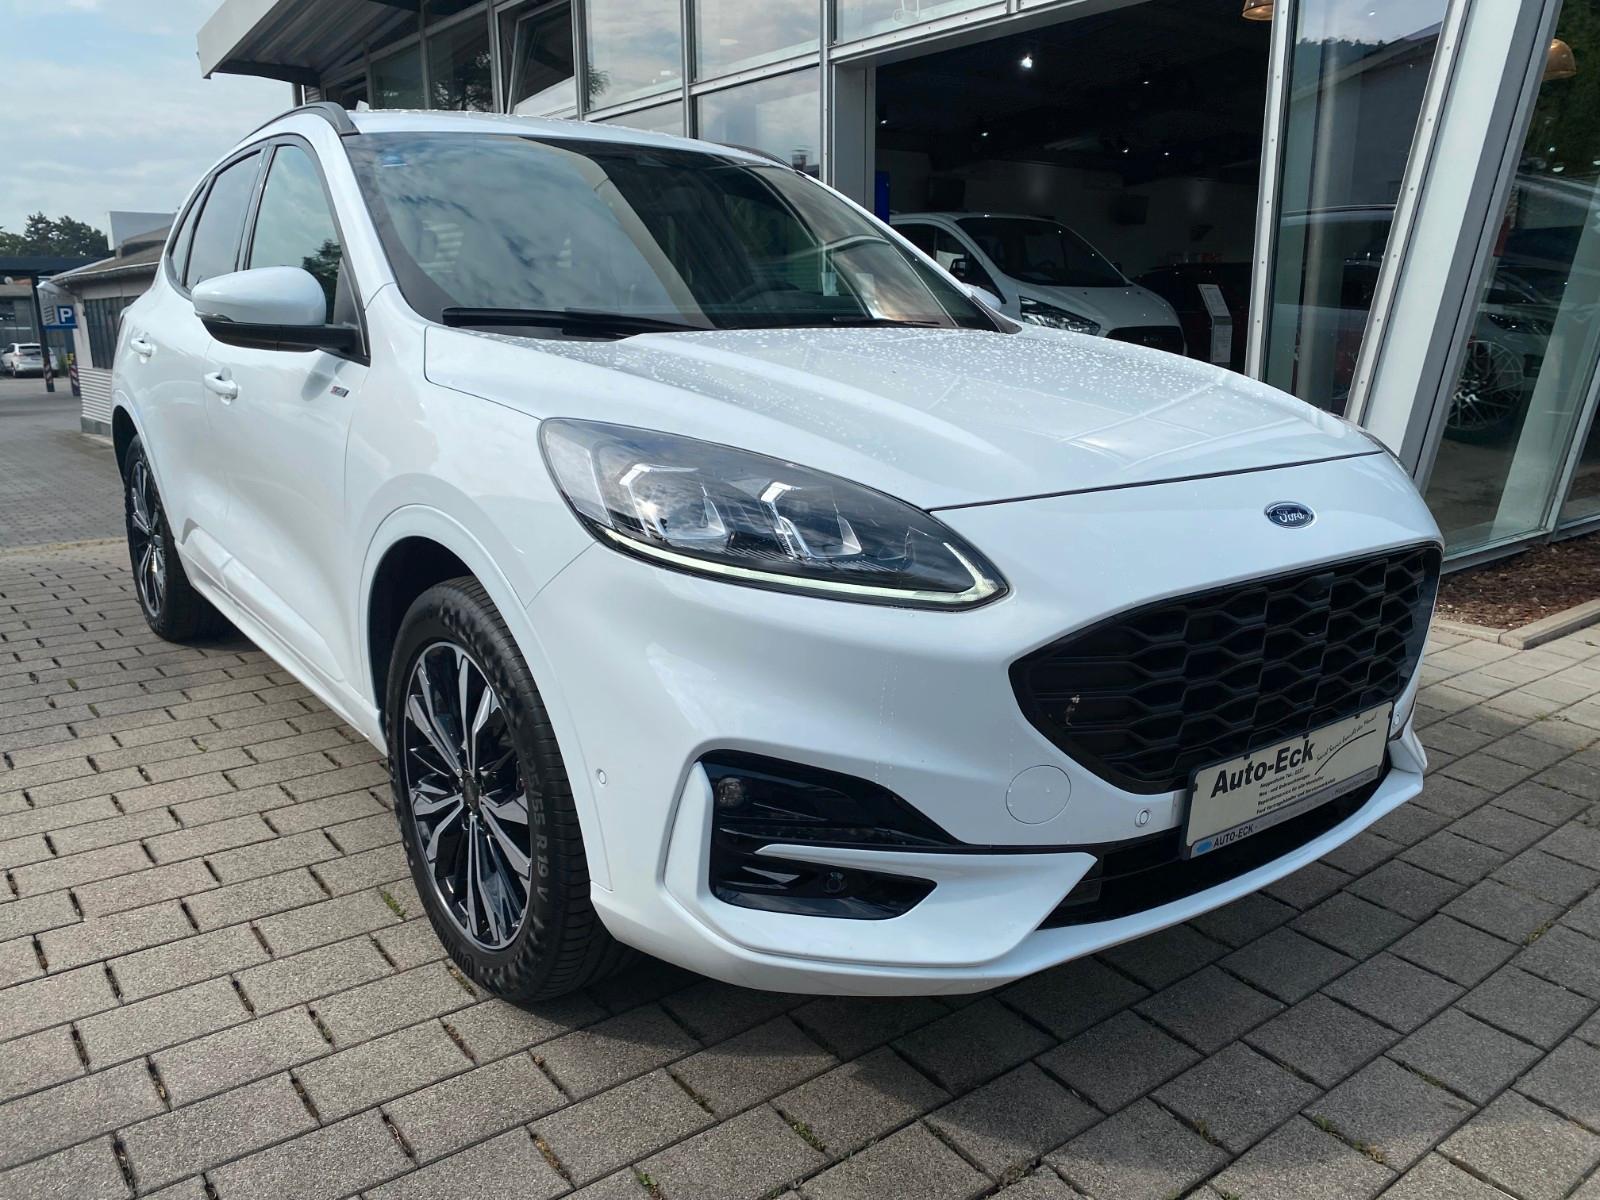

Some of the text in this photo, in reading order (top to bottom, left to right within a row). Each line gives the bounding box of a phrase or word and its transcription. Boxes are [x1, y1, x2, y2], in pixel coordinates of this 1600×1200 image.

[60, 308, 73, 323] P
[1210, 739, 1316, 799] Auto-Eck
[1213, 823, 1254, 849] AUTO-ECK
